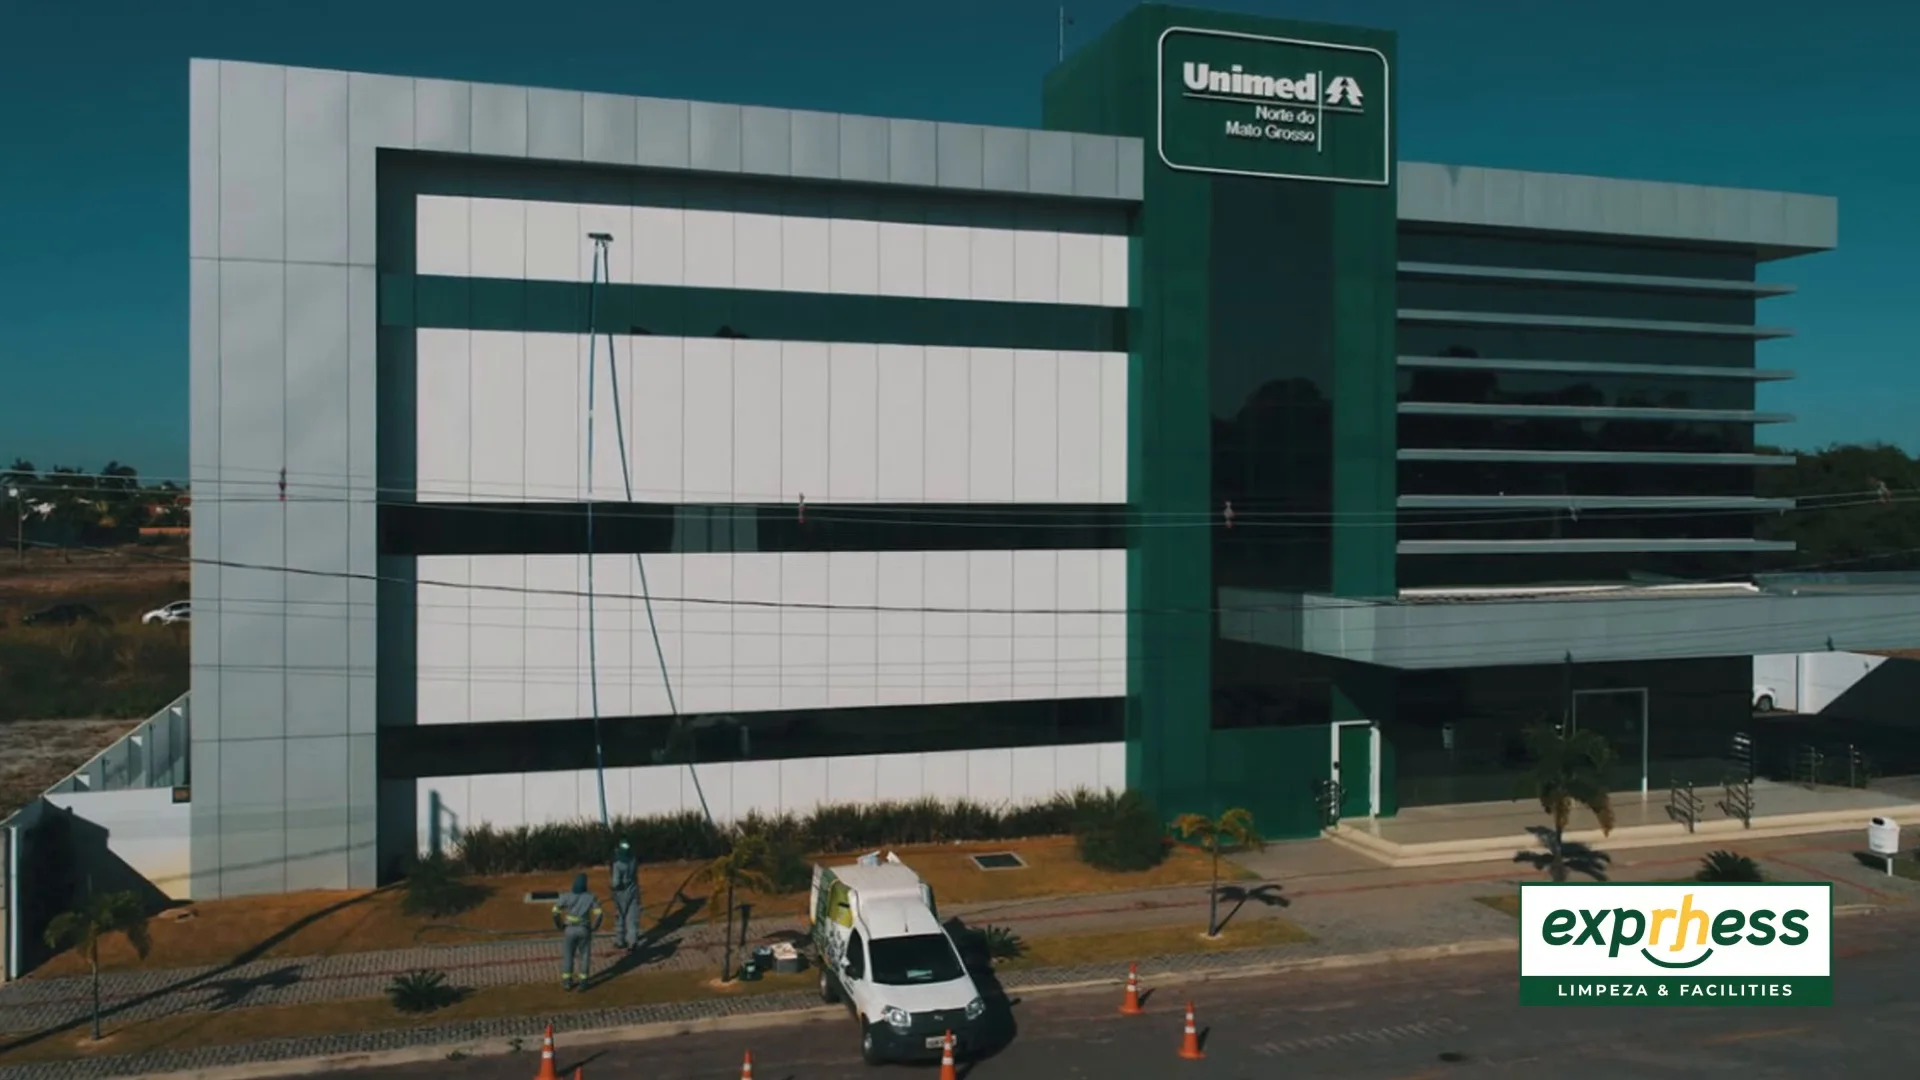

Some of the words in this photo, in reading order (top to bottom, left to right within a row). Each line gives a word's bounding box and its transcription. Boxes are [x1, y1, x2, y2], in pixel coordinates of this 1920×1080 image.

[1183, 61, 1316, 101] Unimed
[1255, 105, 1294, 123] Norte
[1296, 109, 1316, 125] do
[1225, 120, 1262, 138] Mato
[1265, 126, 1315, 142] Grosso
